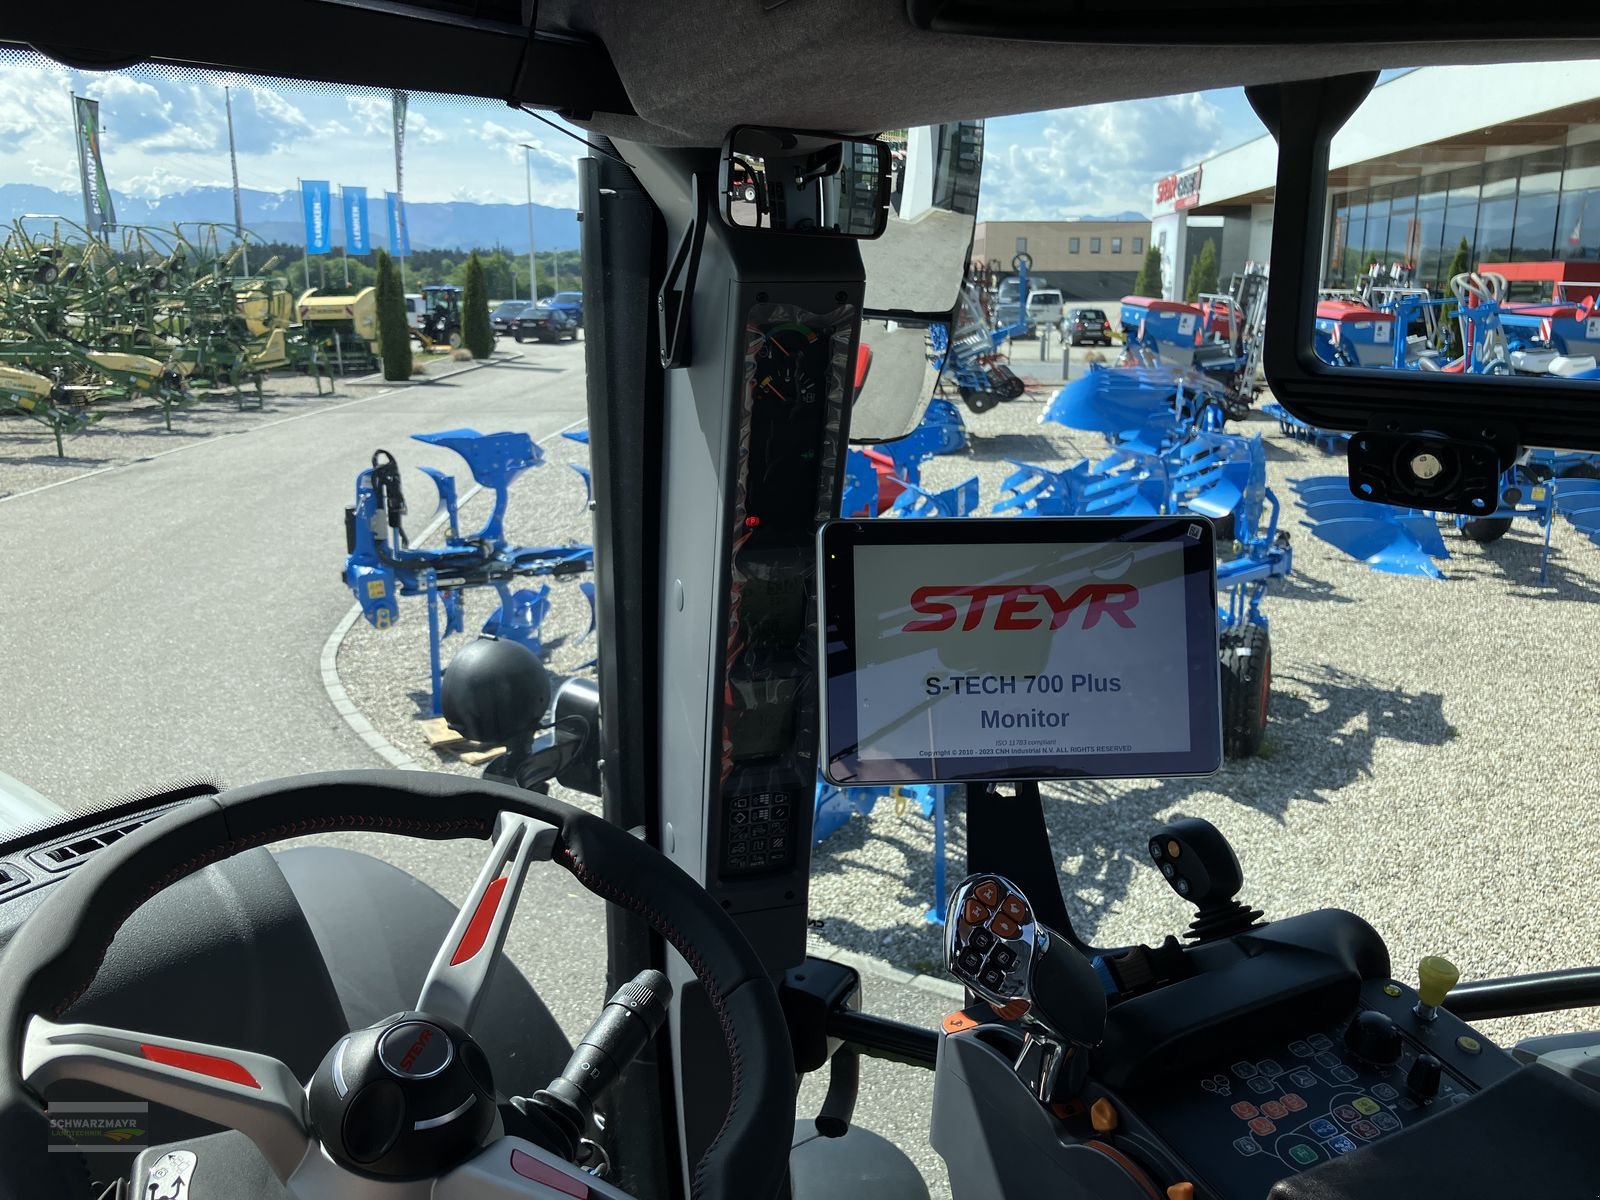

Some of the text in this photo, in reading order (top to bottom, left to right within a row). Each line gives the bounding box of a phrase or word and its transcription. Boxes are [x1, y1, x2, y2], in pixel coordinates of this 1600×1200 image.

[902, 584, 1139, 632] STEYR
[925, 673, 1122, 696] S-TECH 700 Plus
[980, 708, 1070, 729] Monitor
[400, 1029, 433, 1071] STEYR
